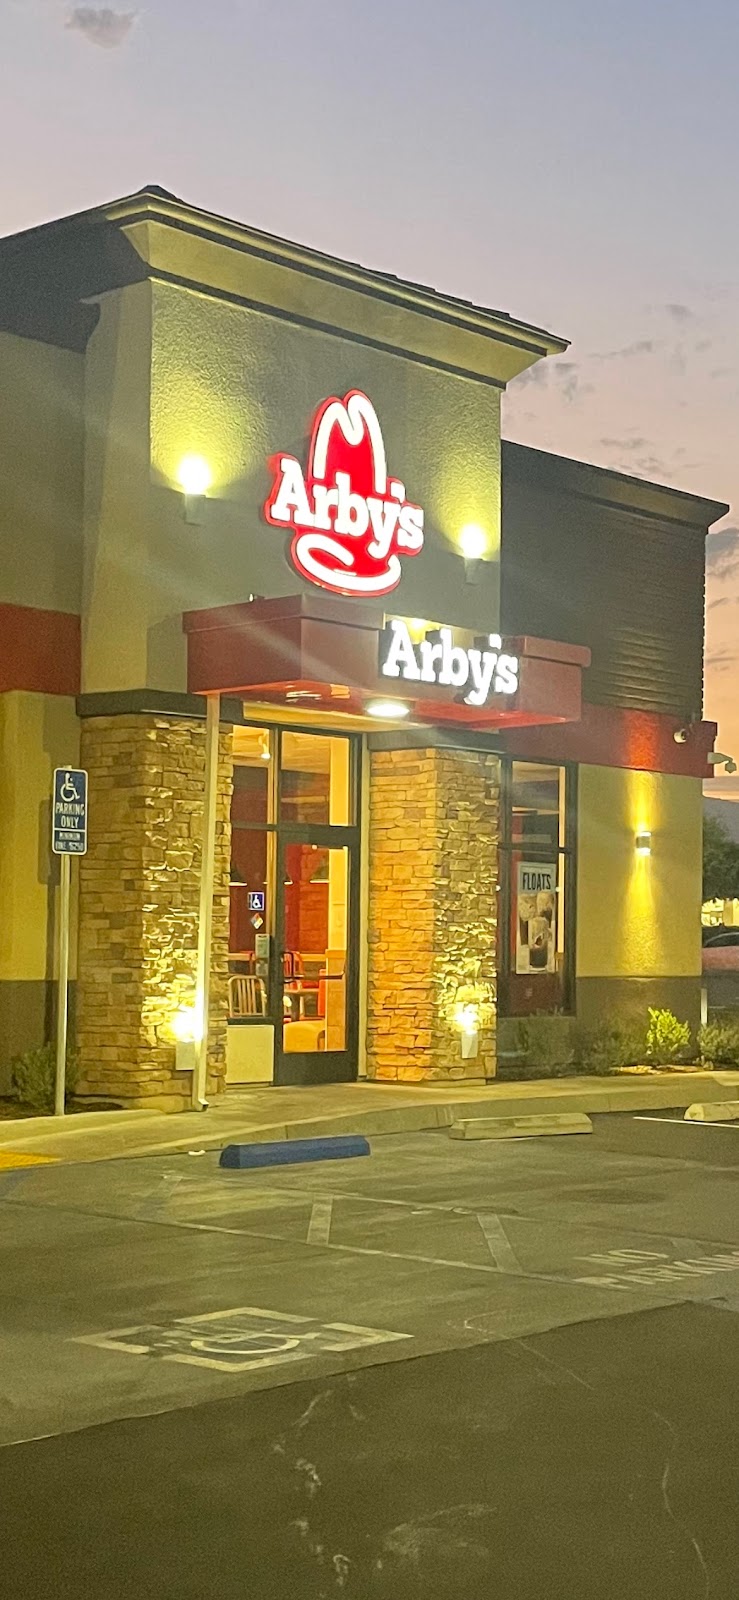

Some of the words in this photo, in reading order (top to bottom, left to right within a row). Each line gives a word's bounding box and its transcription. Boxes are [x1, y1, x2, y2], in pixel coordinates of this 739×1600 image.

[271, 457, 424, 559] Arby's
[382, 619, 519, 706] Arby's
[56, 802, 84, 816] PARKING
[61, 815, 79, 828] ONLY
[522, 872, 552, 891] FLOATS
[572, 1249, 669, 1267] NO
[571, 1251, 739, 1289] PARKIN
